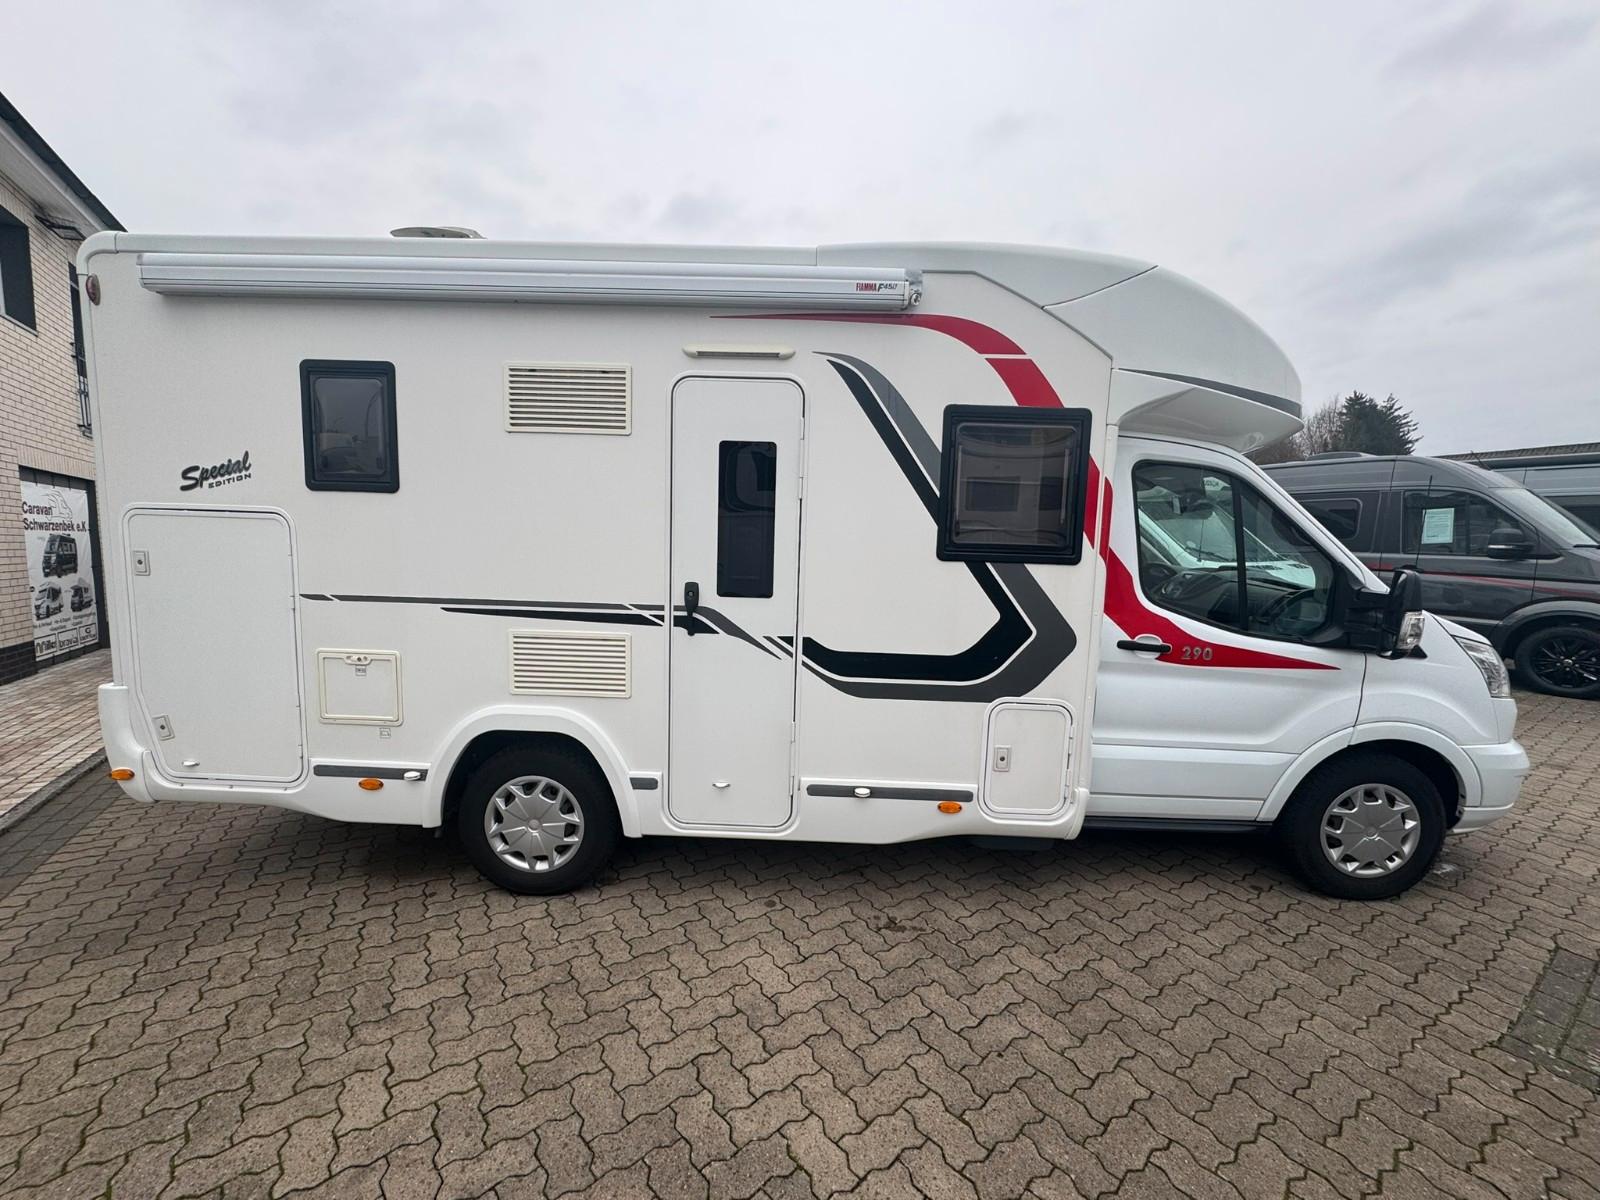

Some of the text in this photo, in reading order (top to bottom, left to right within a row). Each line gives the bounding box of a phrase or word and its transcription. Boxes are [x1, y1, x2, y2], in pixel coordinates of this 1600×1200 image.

[180, 450, 252, 491] Special
[208, 473, 252, 489] EDITION
[22, 501, 53, 516] Caravan
[23, 517, 76, 532] Schwarzenbek
[1181, 646, 1213, 660] 290
